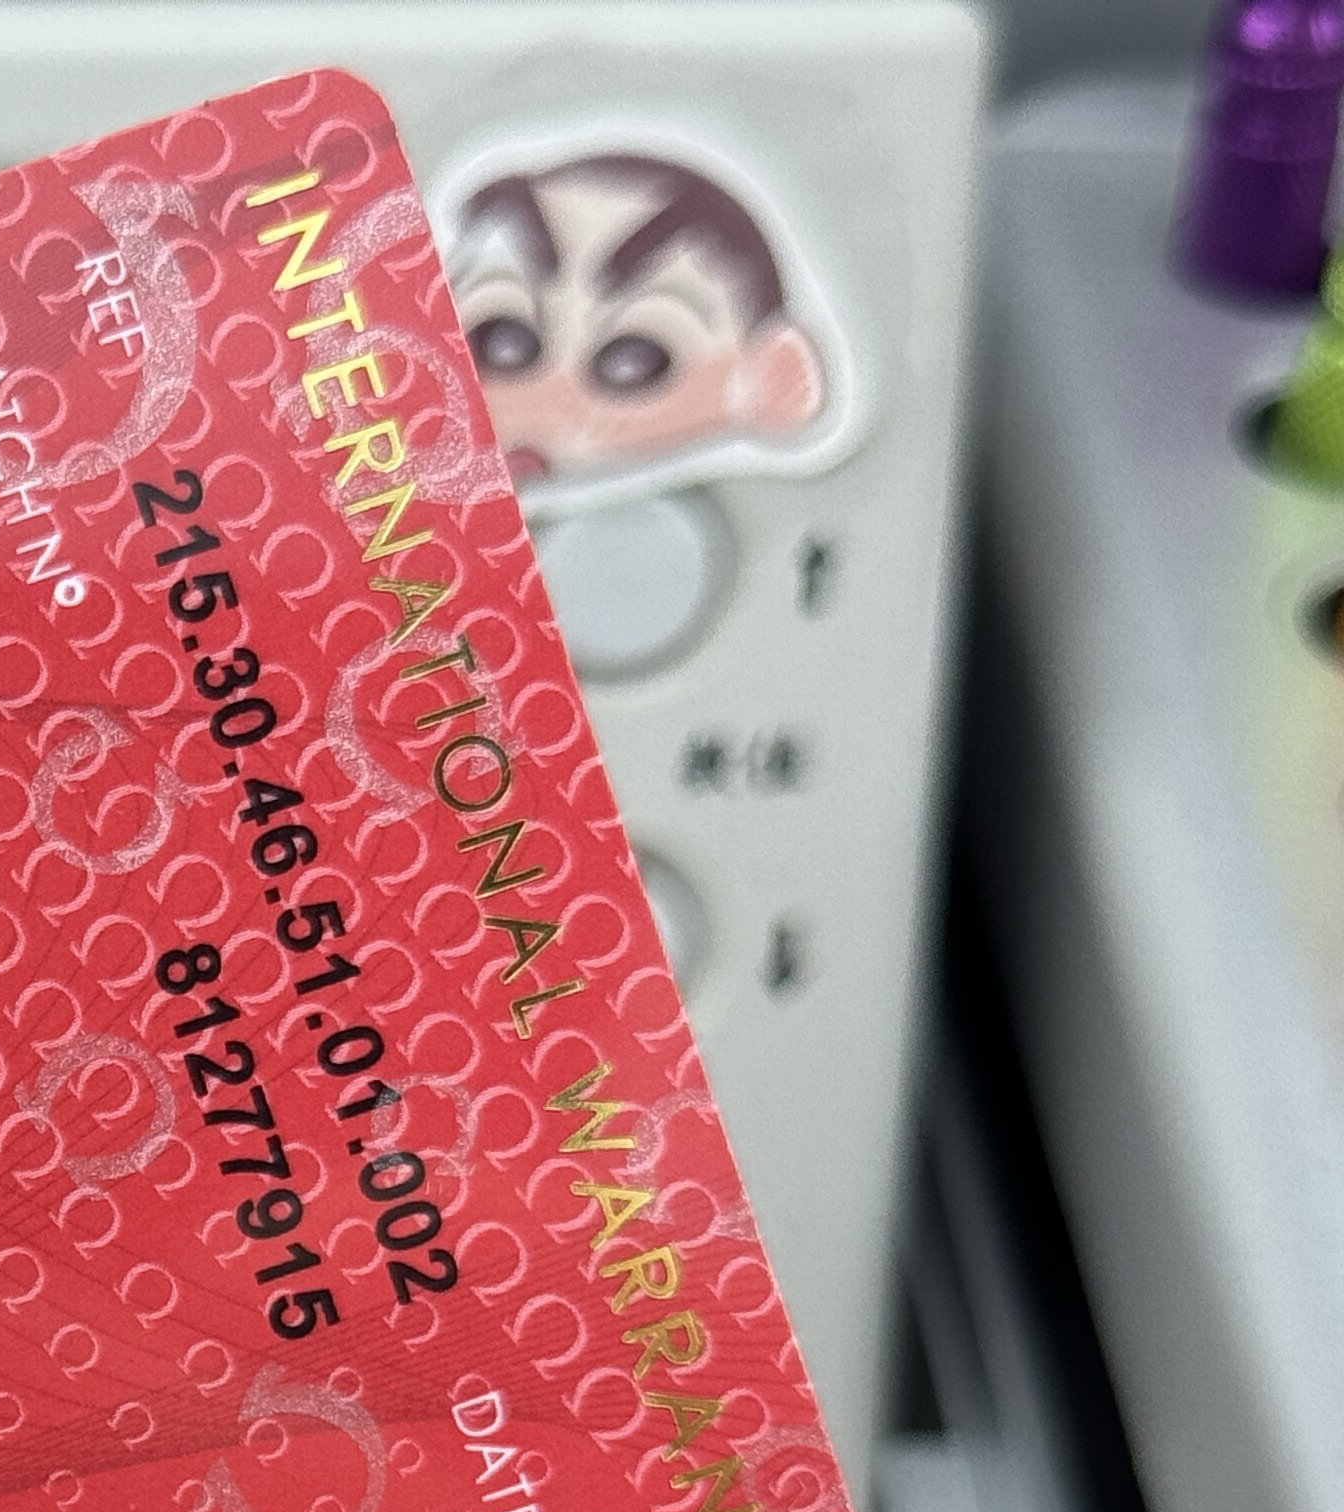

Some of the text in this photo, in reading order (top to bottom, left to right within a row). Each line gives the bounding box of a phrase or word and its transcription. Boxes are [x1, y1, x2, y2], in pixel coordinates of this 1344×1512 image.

[72, 248, 144, 360] REF
[245, 172, 585, 1040] INTERNATIONAL
[132, 468, 458, 1306] 215.30.46.51.01.002
[154, 942, 342, 1342] 81277915
